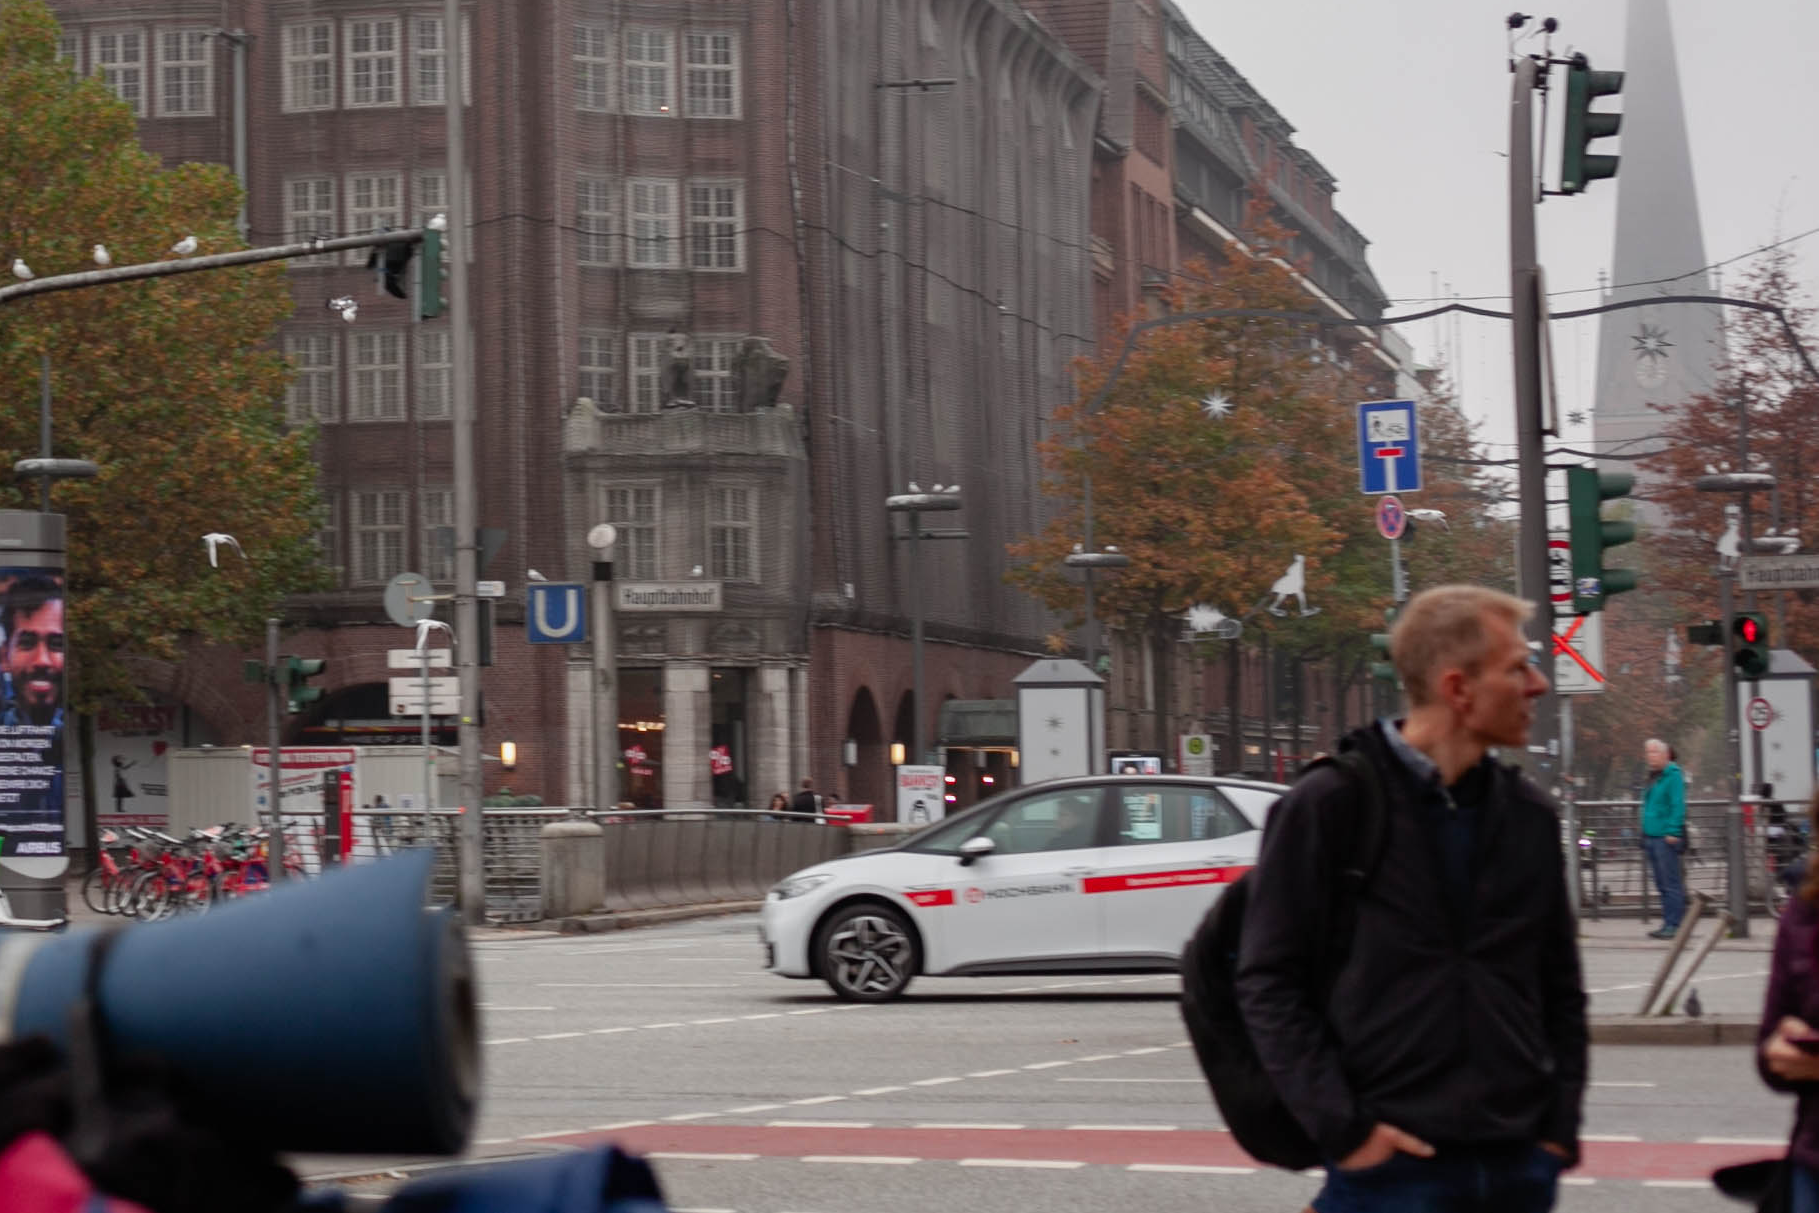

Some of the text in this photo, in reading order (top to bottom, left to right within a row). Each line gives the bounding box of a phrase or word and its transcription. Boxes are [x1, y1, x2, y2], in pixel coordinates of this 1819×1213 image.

[623, 587, 715, 607] Hauptbahnhof
[534, 589, 578, 638] U
[16, 841, 62, 854] AIRBUS
[984, 883, 1073, 899] HOCHBAHN
